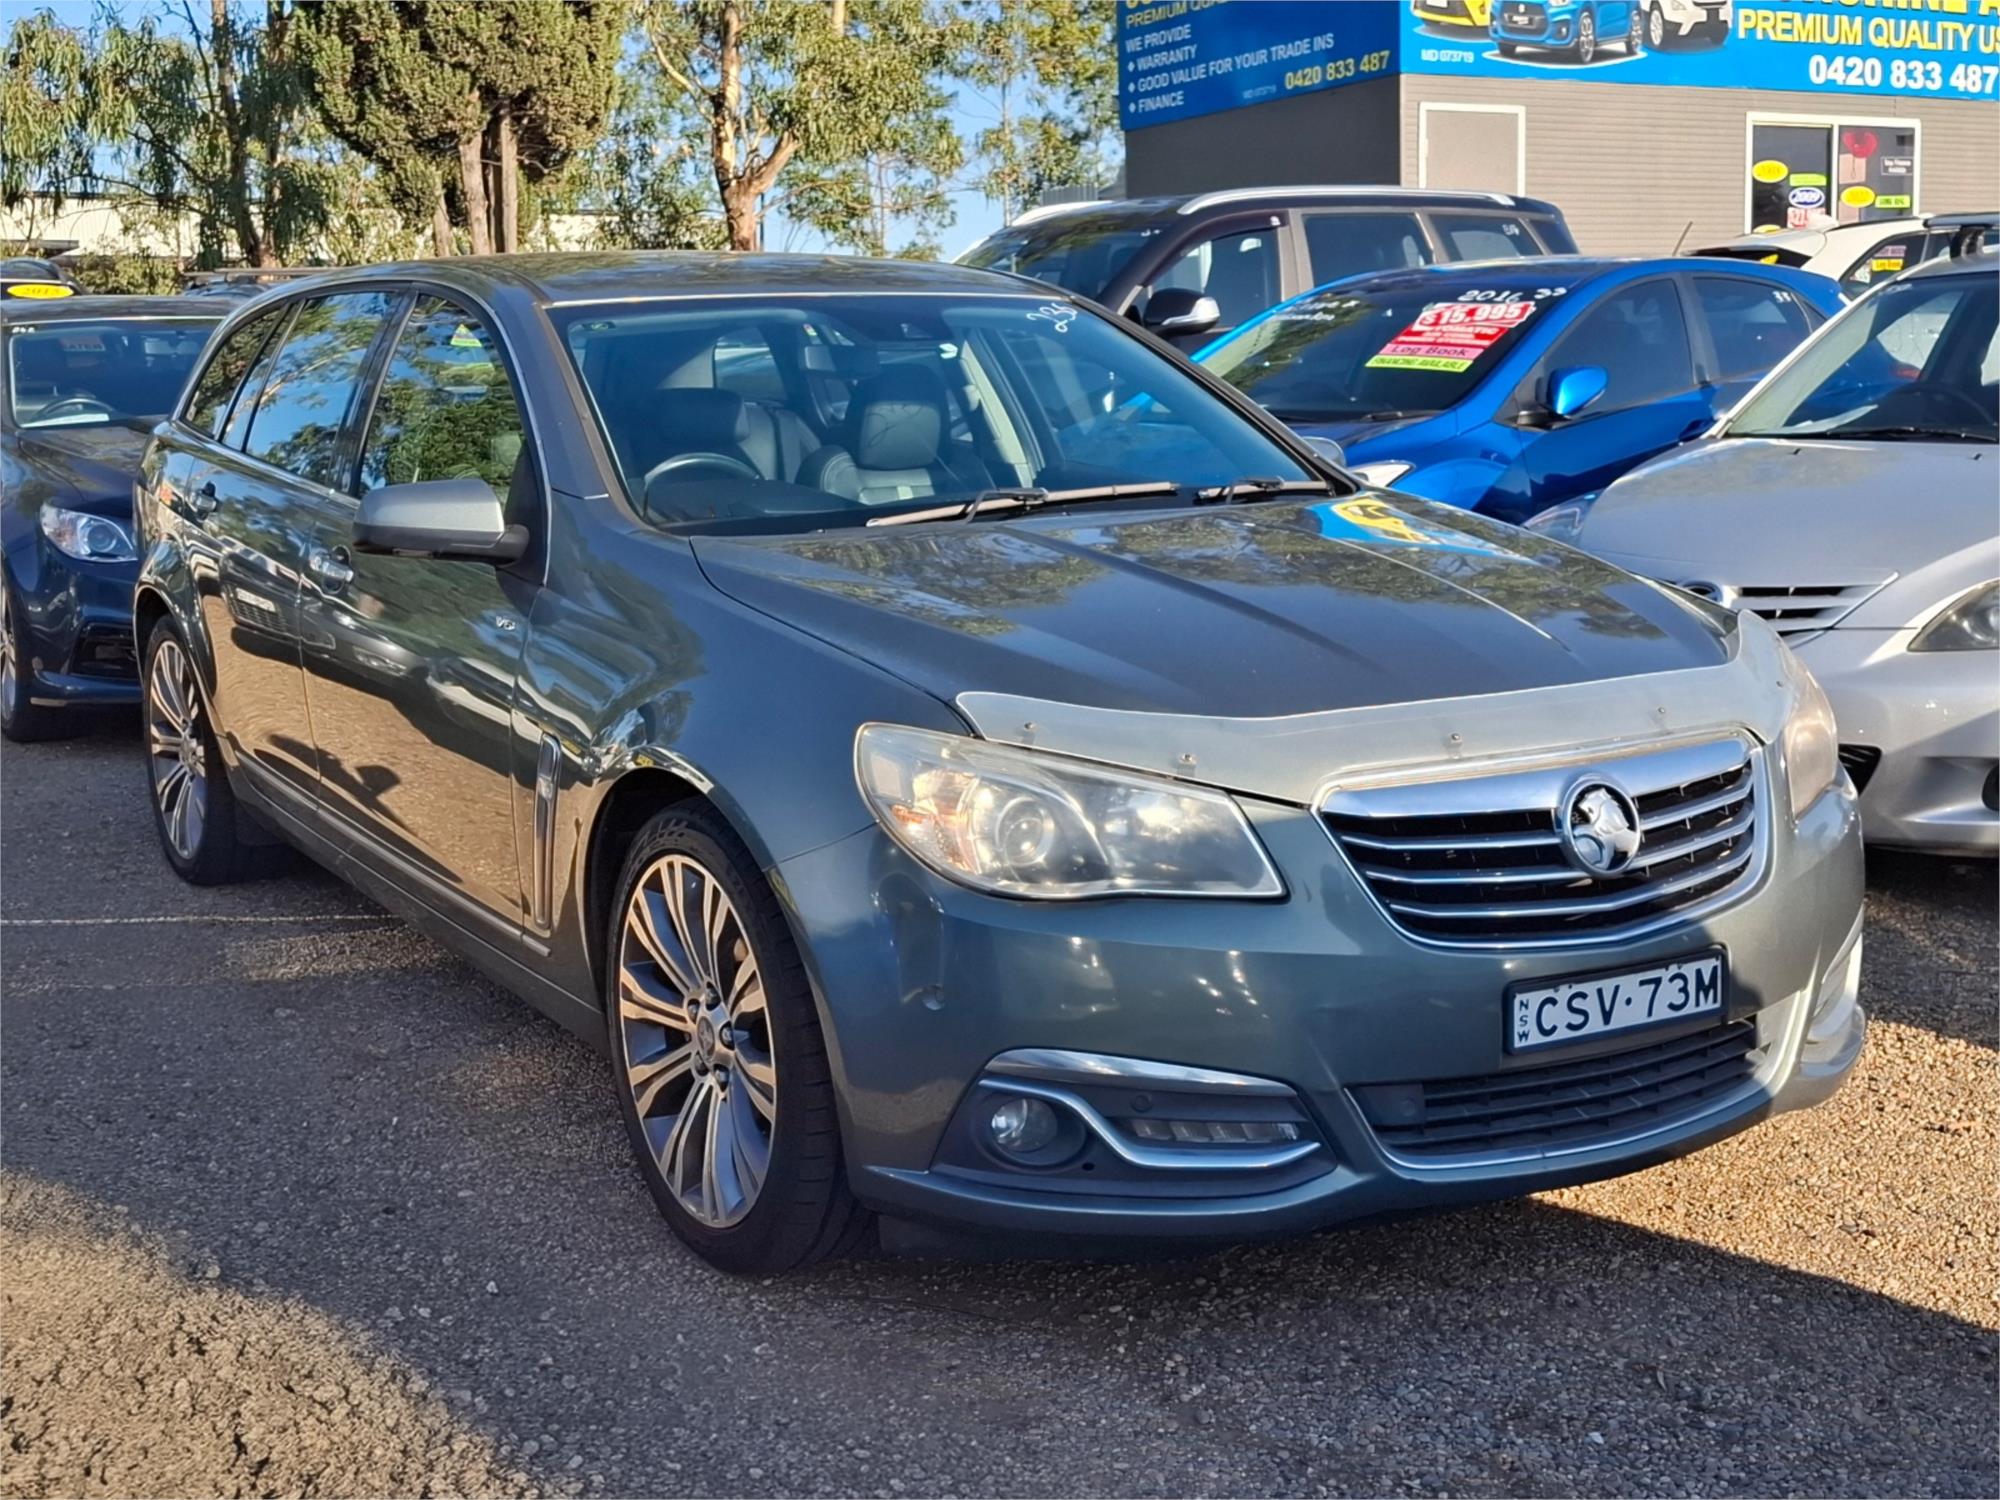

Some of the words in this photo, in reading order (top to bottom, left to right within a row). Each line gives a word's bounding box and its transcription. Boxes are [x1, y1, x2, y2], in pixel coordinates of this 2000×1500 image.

[1125, 36, 1143, 53] WE
[1144, 24, 1191, 49] PROVIDE
[1737, 8, 1863, 46] PREMIUM
[1868, 16, 1975, 52] QUALITY
[1136, 44, 1198, 71] WARRANTY
[1137, 72, 1169, 93] GOOD
[1171, 64, 1207, 84] VALUE
[1208, 60, 1233, 77] FOR
[1234, 52, 1268, 68] YOUR
[1270, 39, 1311, 62] TRADE
[1313, 33, 1334, 51] INS
[1284, 66, 1322, 90] 0420
[1326, 57, 1355, 80] 833
[1359, 50, 1390, 73] 487
[1809, 54, 1882, 87] 0420
[1890, 59, 1942, 91] 833
[1950, 63, 1999, 94] 487
[1138, 90, 1184, 113] FINANCE
[1391, 345, 1421, 355] Log
[1425, 347, 1468, 356] Book
[1518, 999, 1530, 1043] NSW
